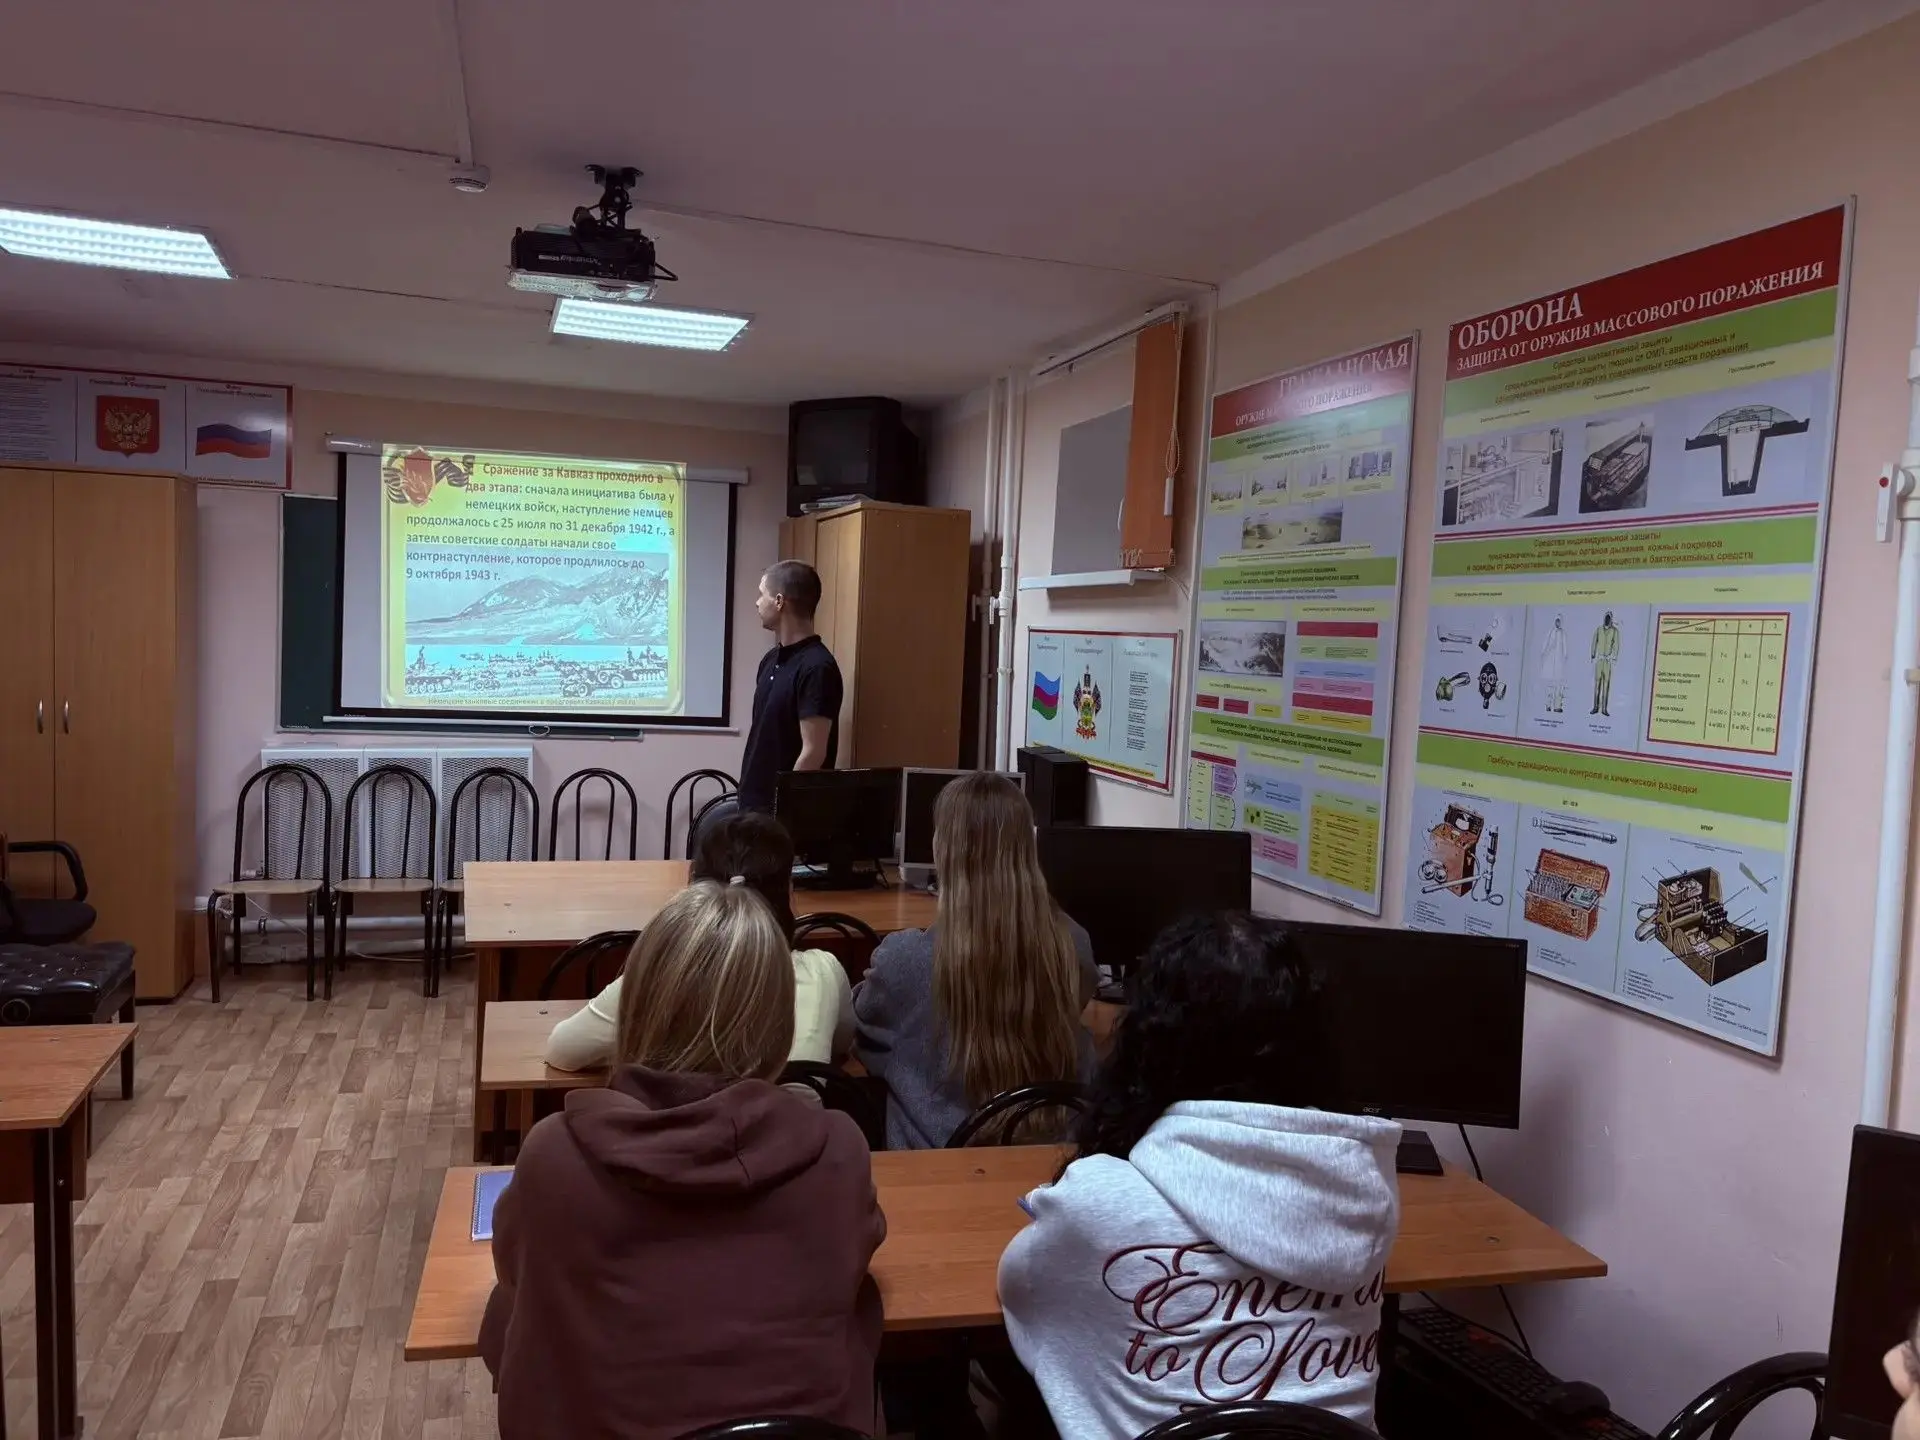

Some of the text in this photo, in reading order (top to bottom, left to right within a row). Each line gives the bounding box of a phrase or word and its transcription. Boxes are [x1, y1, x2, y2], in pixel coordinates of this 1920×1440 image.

[1457, 260, 1825, 371] ЗАЩИТА ОТ ОРУЖИЯ МАССОВОГО ПОРАЖЕНИЯ
[1458, 292, 1583, 350] ОБОРОНА
[483, 463, 663, 484] Сражение за Кавказ проходило в
[465, 482, 675, 504] два этапа: сначала инициатива была у
[465, 500, 673, 520] немецких войск, наступление немцев
[406, 515, 675, 537] продолжалось с 25 июля по 31 декабря 1942 г., а
[406, 533, 617, 550] затем советские солдаты начали свое
[406, 551, 645, 570] контрнаступление, которое продлилось до
[406, 567, 501, 581] 9 октября 1943 г.
[1125, 1330, 1191, 1381] to
